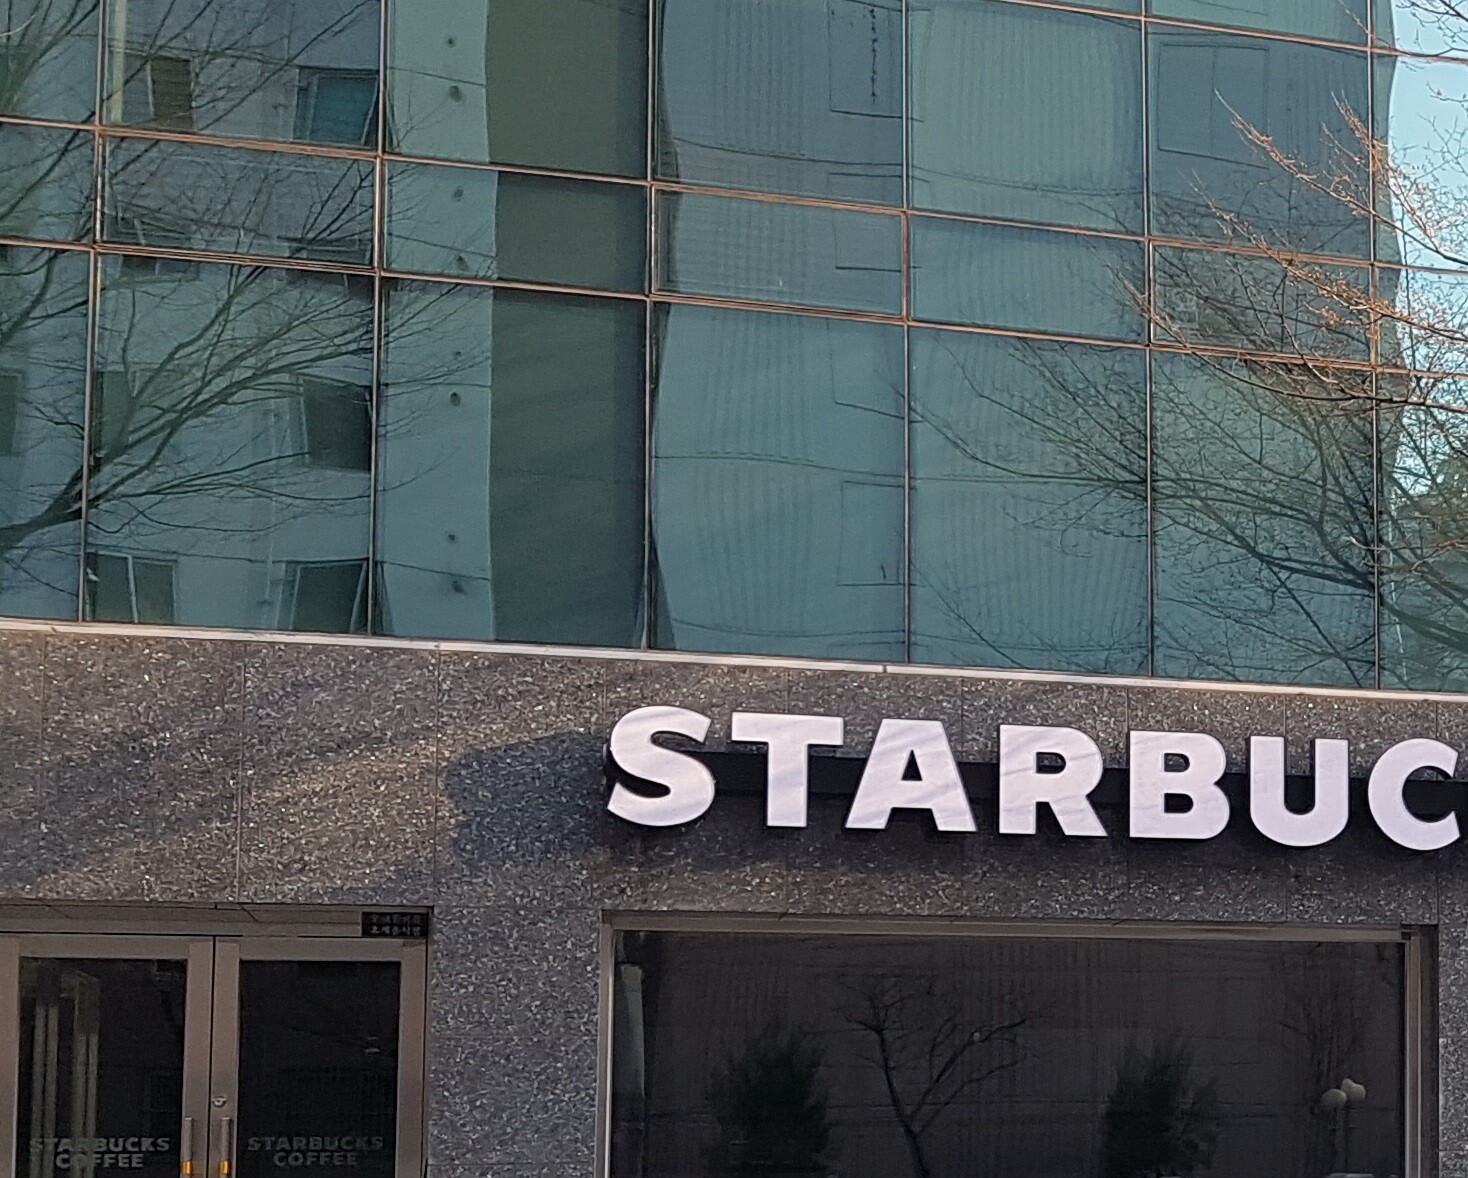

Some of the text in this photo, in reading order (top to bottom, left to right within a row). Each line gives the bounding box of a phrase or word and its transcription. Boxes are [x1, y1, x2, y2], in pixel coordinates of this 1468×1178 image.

[30, 1136, 171, 1152] STARBUCKS
[247, 1136, 384, 1151] STARBUCKS
[273, 1151, 359, 1167] COFFEE
